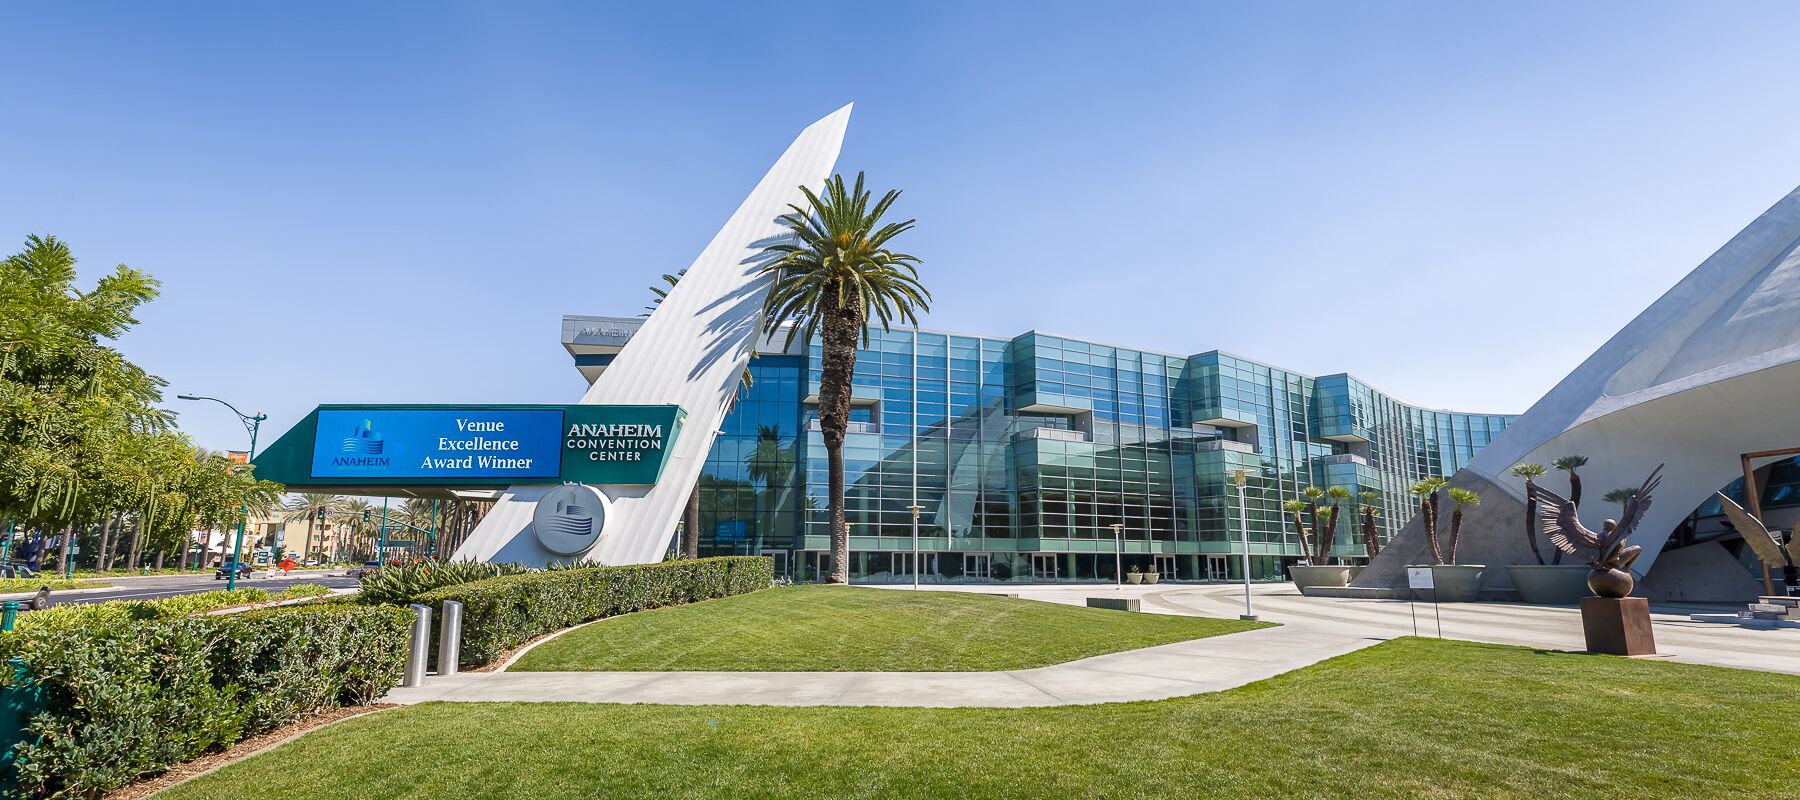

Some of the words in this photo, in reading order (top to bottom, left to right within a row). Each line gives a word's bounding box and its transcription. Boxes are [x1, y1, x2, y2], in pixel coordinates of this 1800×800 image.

[456, 418, 505, 432] Venue
[567, 423, 662, 438] ANAHEIM
[438, 437, 519, 451] Excellence
[567, 439, 661, 450] CONVENTION
[331, 457, 390, 466] ANAHEIM
[420, 456, 473, 469] Award
[477, 456, 533, 469] Winner
[589, 451, 641, 461] CENTER
